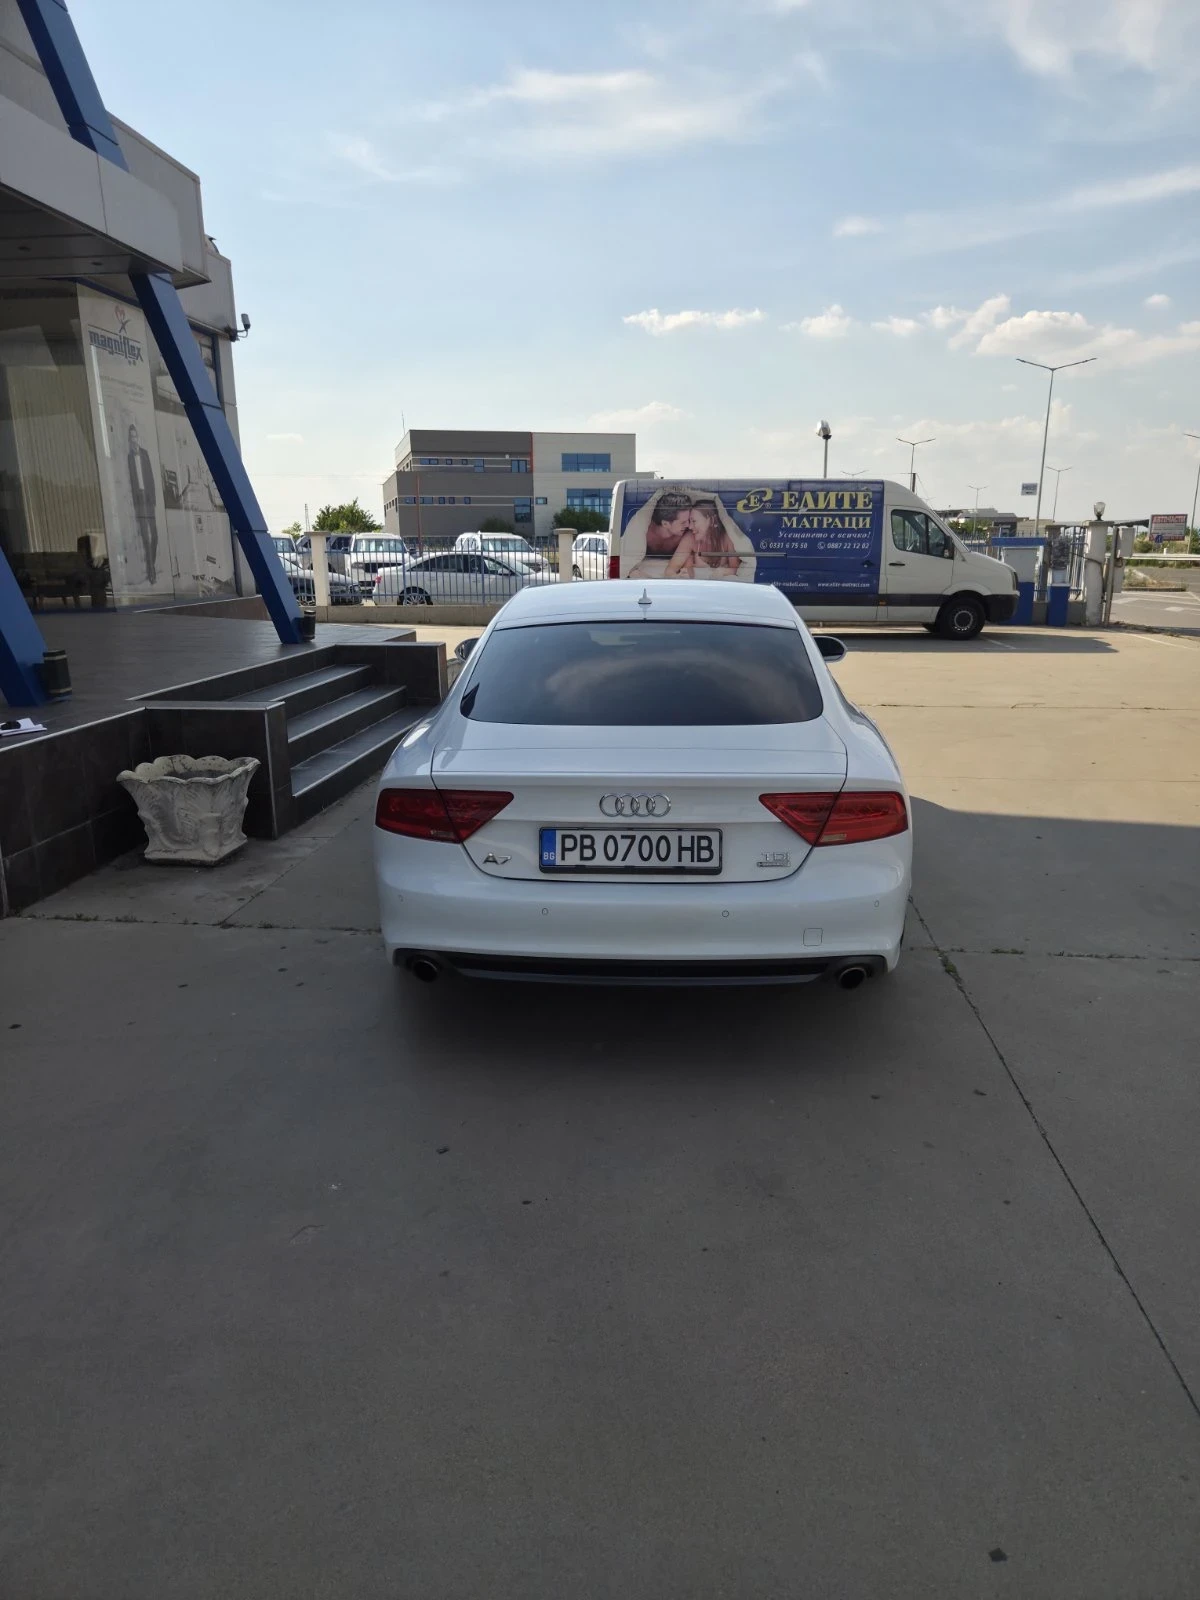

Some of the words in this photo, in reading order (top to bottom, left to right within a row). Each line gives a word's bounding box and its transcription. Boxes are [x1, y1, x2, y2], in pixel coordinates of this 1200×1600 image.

[88, 330, 144, 362] magniflex
[781, 516, 871, 530] МАТРАЦИ
[778, 531, 828, 540] Усещането
[603, 834, 671, 862] 0700
[482, 852, 512, 865] A7
[543, 852, 555, 860] BG
